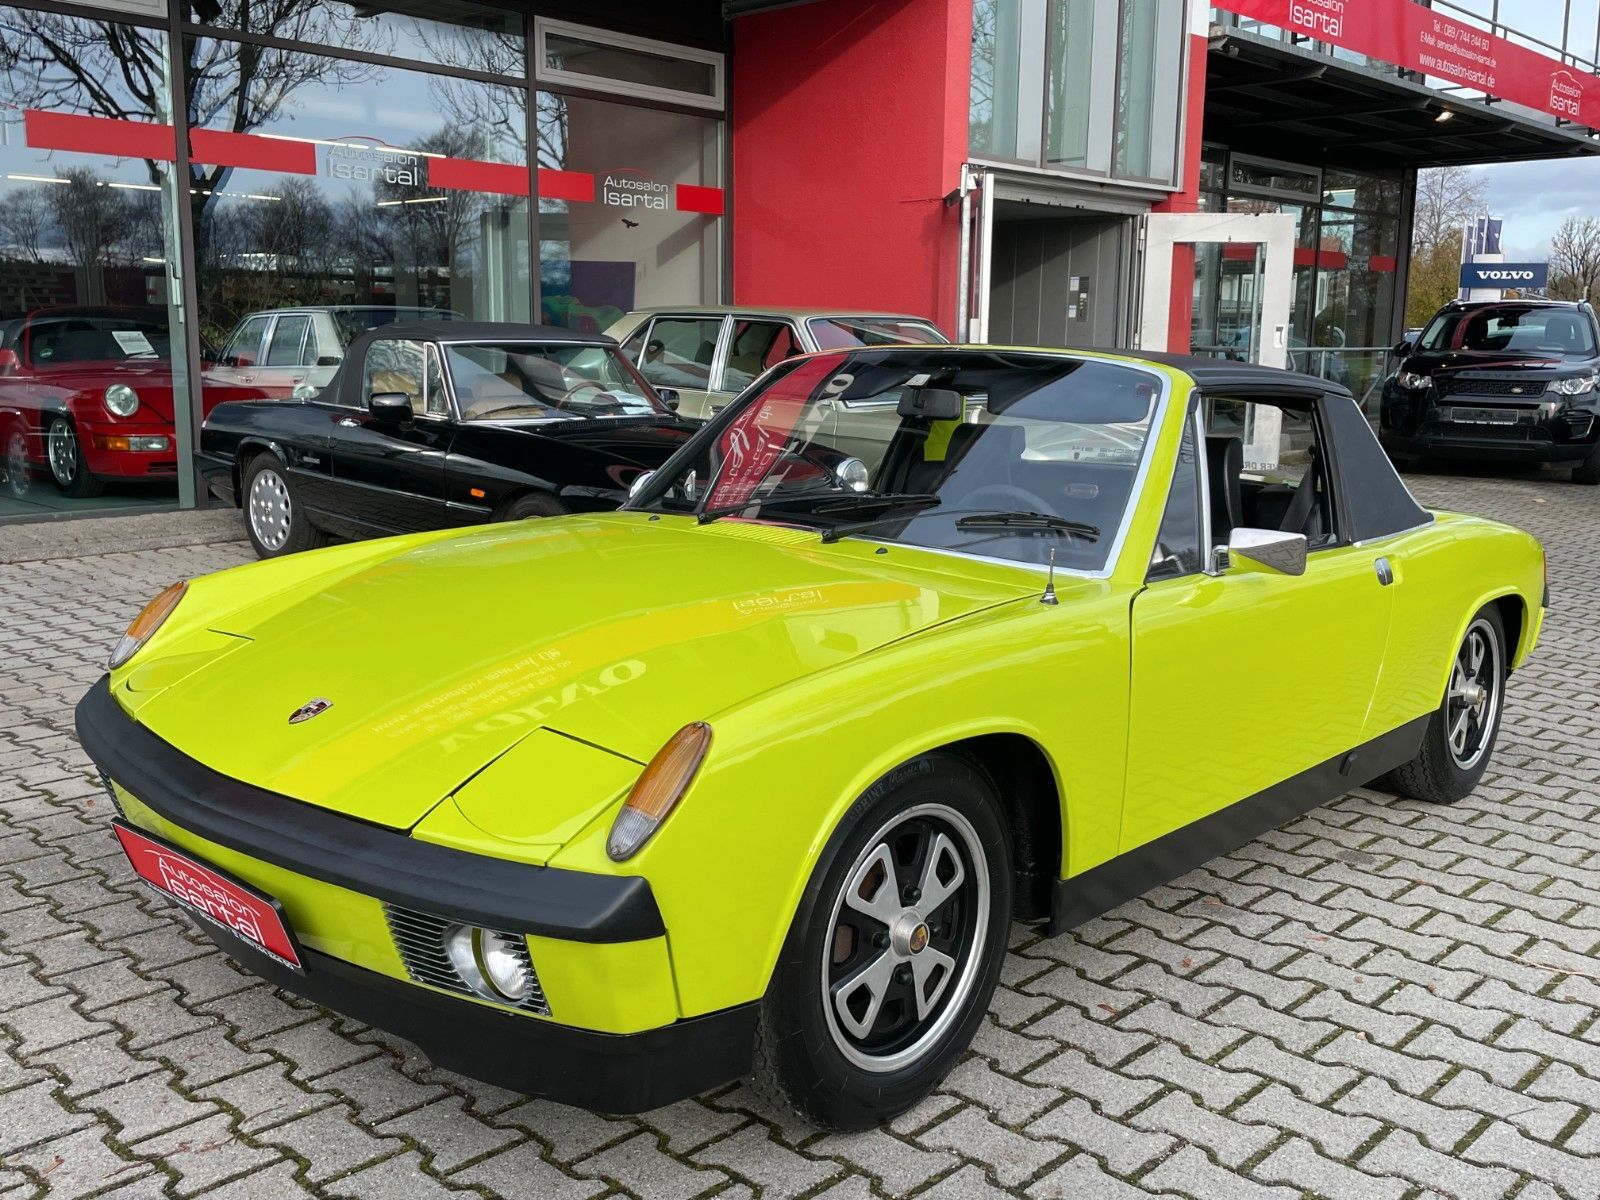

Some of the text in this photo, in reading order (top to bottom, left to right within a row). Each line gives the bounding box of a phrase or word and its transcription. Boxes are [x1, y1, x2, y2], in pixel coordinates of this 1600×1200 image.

[1289, 0, 1343, 38] Isartal
[1443, 23, 1456, 39] 089
[1460, 29, 1470, 45] 744
[1471, 34, 1481, 47] 244
[1419, 53, 1495, 88] www.autosalon-isartal.de
[1552, 78, 1581, 98] Autosalon
[1550, 89, 1580, 116] Isartal
[330, 157, 418, 186] Isartal
[604, 175, 668, 192] Autosalon
[603, 187, 668, 210] Isartal
[1477, 270, 1534, 280] VOLVO
[158, 856, 254, 918] Autosalon
[160, 868, 266, 946] Isartal
